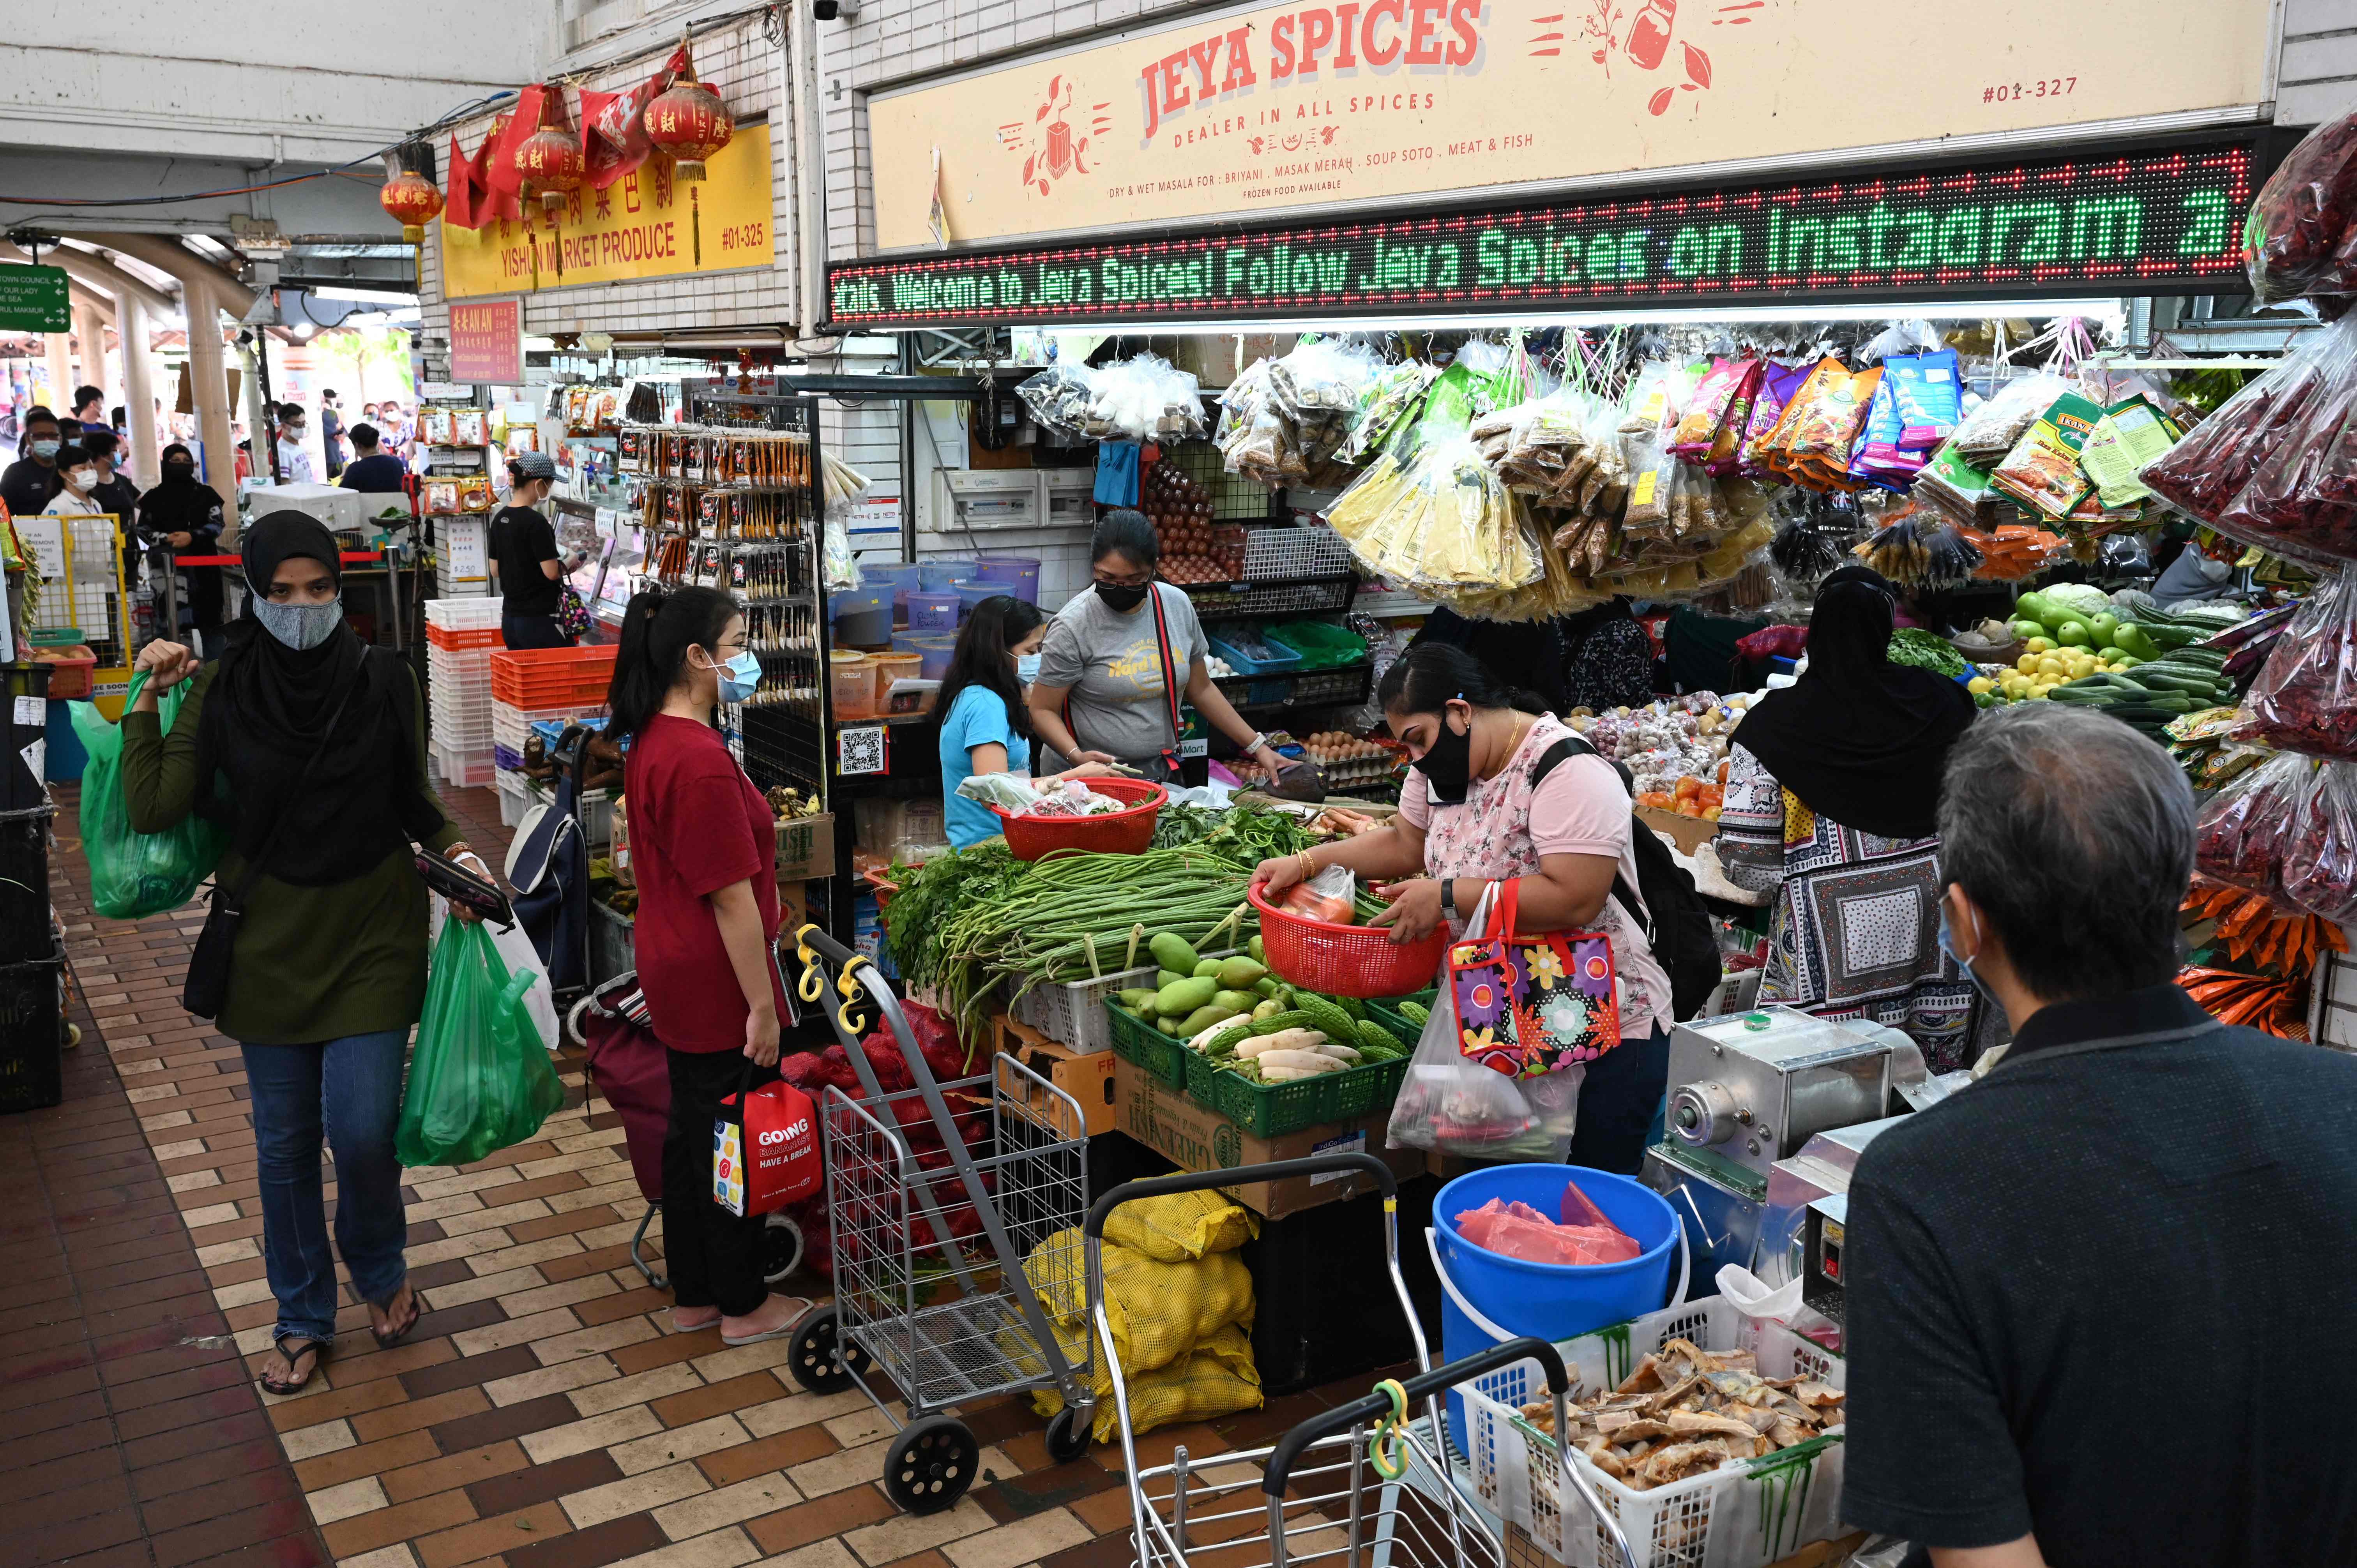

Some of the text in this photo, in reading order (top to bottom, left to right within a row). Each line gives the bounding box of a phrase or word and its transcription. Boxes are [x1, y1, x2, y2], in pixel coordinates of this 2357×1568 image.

[1142, 0, 1482, 139] JEYA SPICES
[1983, 77, 2077, 103] #01-327
[1174, 93, 1433, 148] DEALER IN ALL SPICES
[1110, 187, 1124, 198] DRY
[1128, 186, 1133, 196] &
[1137, 183, 1154, 195] WET
[1158, 178, 1193, 192] MASALA
[1197, 176, 1214, 187] FOR
[1225, 169, 1263, 184] BRIYANI
[1275, 162, 1310, 178] MASAK
[1315, 157, 1352, 174] MERAH
[1366, 151, 1397, 166] SOUP
[1402, 146, 1433, 162] SOTO
[1448, 140, 1483, 156] MEAT
[1488, 138, 1497, 151] &
[1504, 133, 1533, 149] FISH
[1243, 180, 1341, 199] FROZEN FOOD AVAILABLE
[501, 221, 676, 277] YISHUN MARKET PRODUCE
[722, 223, 763, 251] #01-325
[892, 272, 993, 310] Welcome
[1225, 245, 1349, 295] Follow
[1672, 224, 1742, 276] on
[2179, 189, 2227, 254] a
[20, 277, 51, 285] COUNCIL
[469, 307, 492, 333] AN AN
[2061, 417, 2086, 429] IKAN
[1108, 656, 1148, 678] Hard
[759, 1118, 808, 1146] GOING
[760, 1132, 811, 1157] BANANAS?
[1319, 1135, 1355, 1150] IndiGo CarGo
[760, 1144, 811, 1169] HAVE A BREAK
